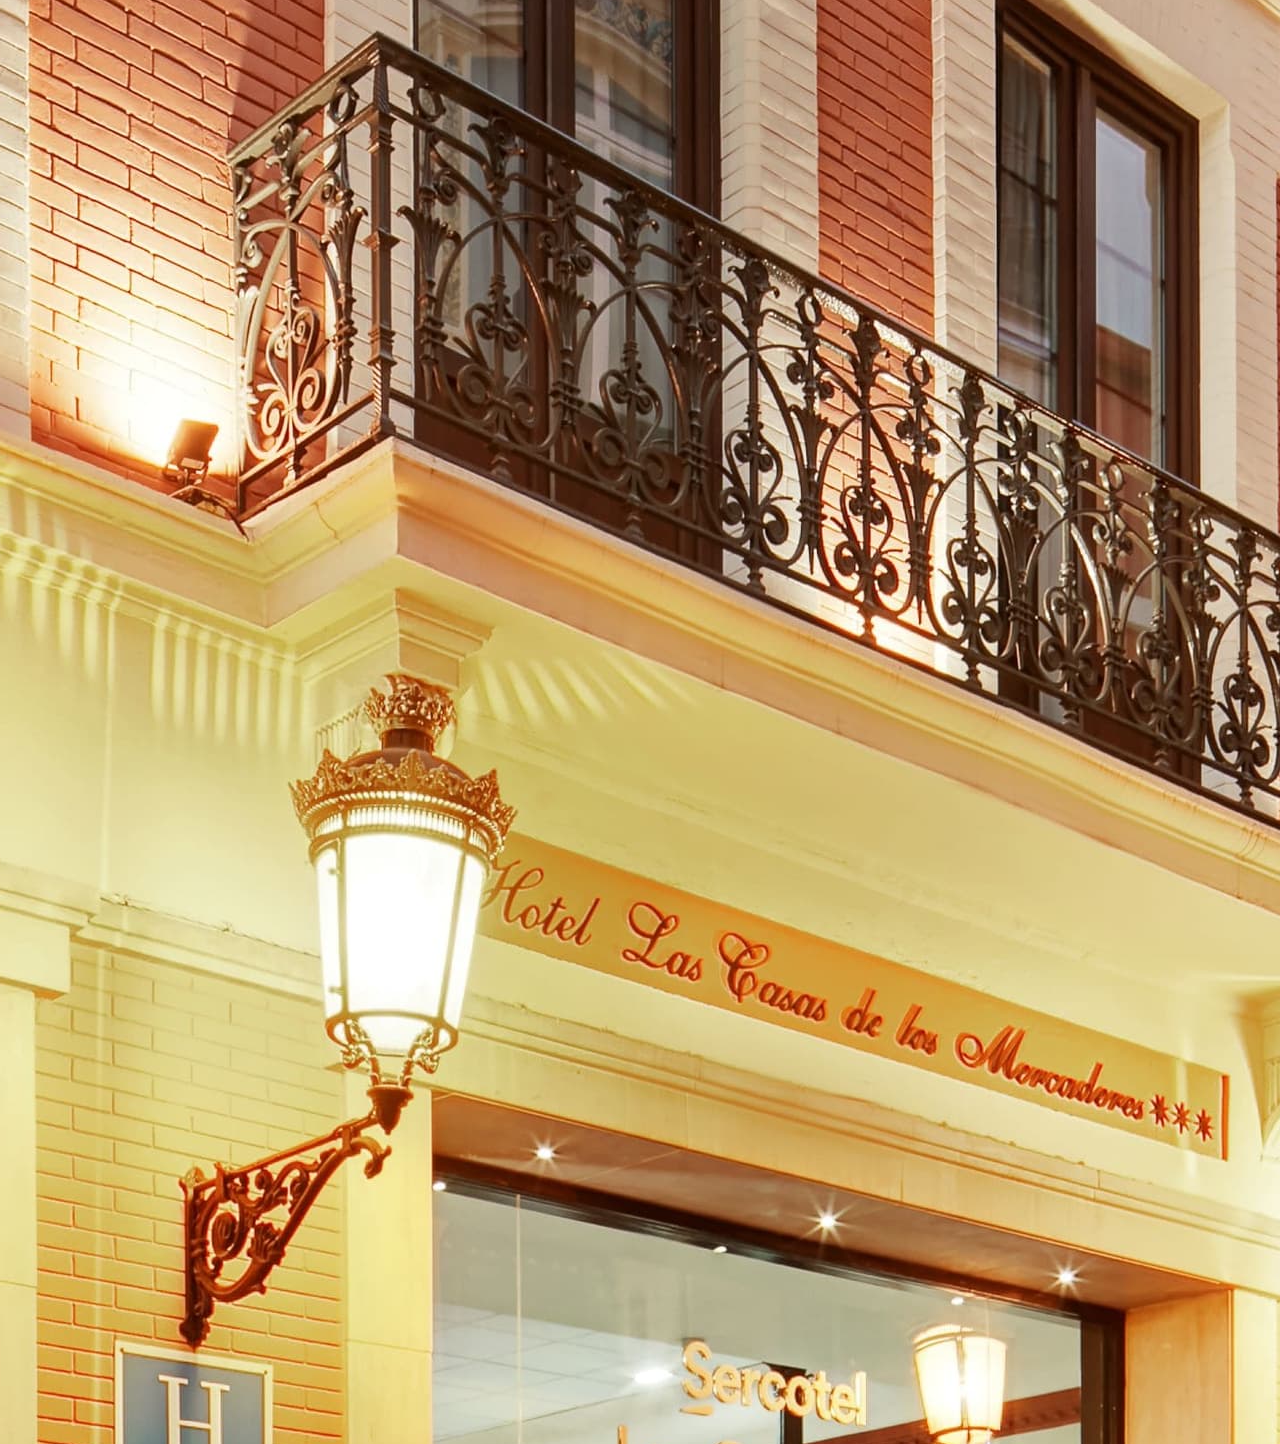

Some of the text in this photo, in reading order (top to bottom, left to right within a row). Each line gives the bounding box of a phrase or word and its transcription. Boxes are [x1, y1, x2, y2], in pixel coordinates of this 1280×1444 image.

[480, 859, 1145, 1121] Hotel Las Casas de los Mercaderes
[681, 1341, 868, 1426] Sercotel
